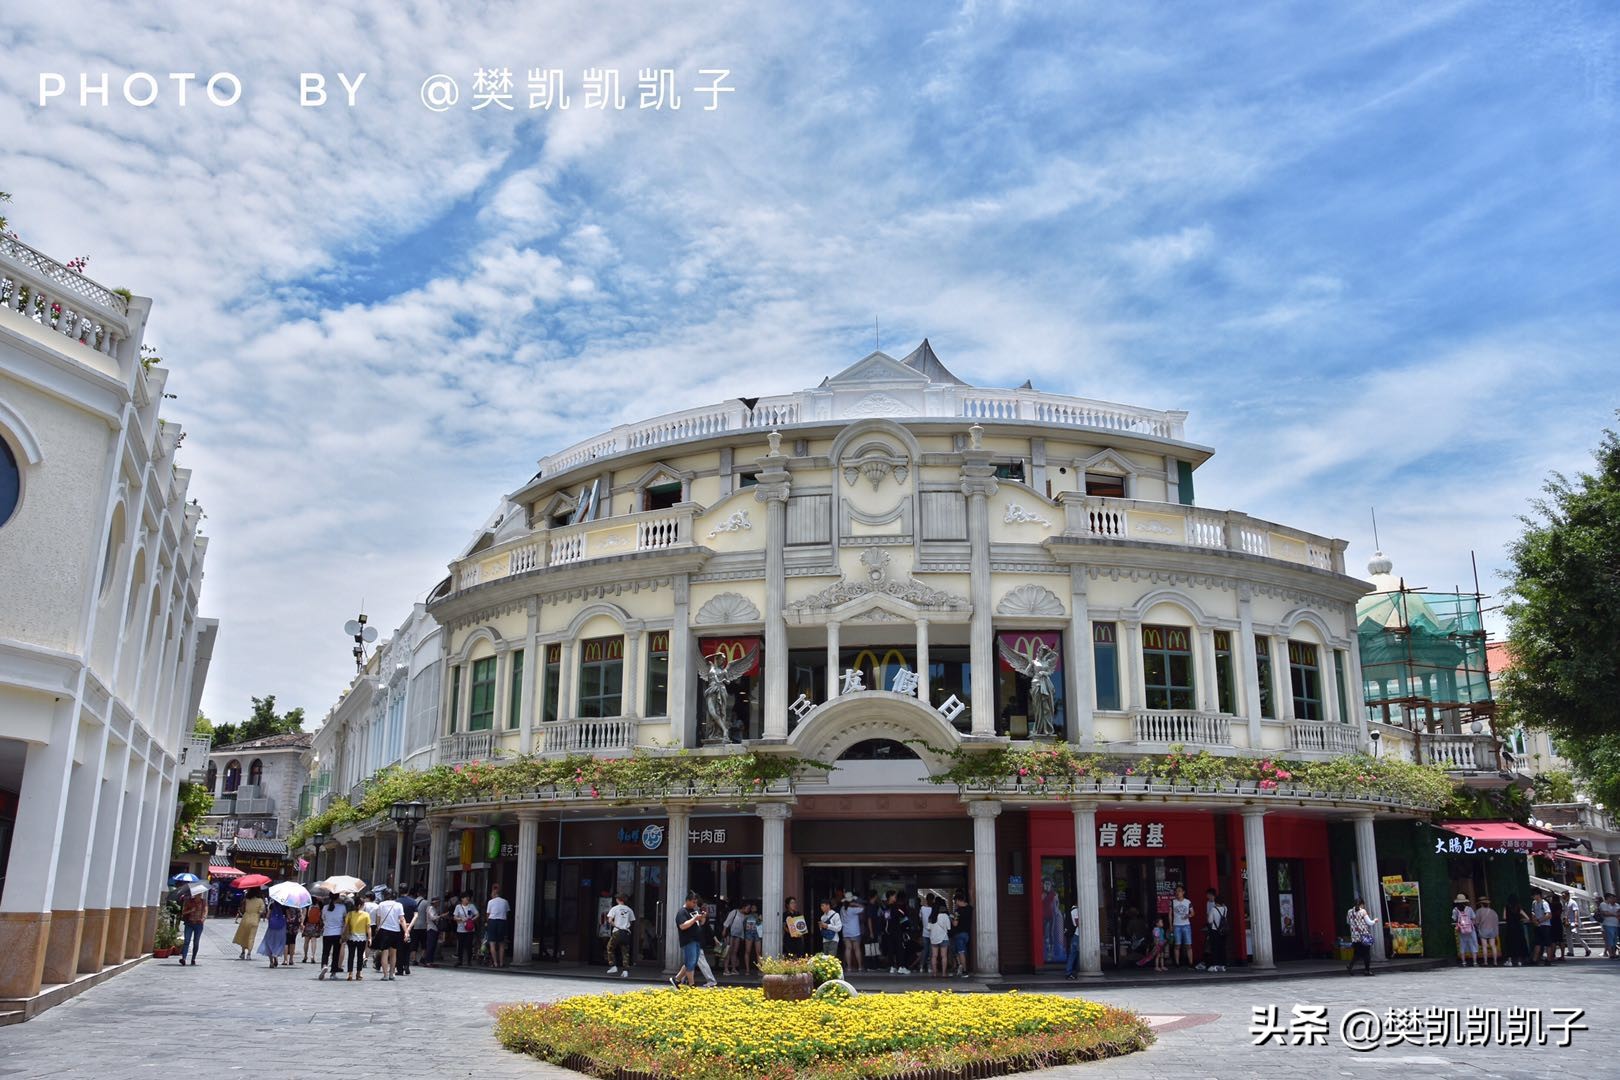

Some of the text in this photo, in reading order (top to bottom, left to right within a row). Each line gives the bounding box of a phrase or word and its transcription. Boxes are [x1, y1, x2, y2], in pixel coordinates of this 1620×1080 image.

[688, 829, 726, 843] 牛肉面
[1099, 822, 1164, 848] 肯德基
